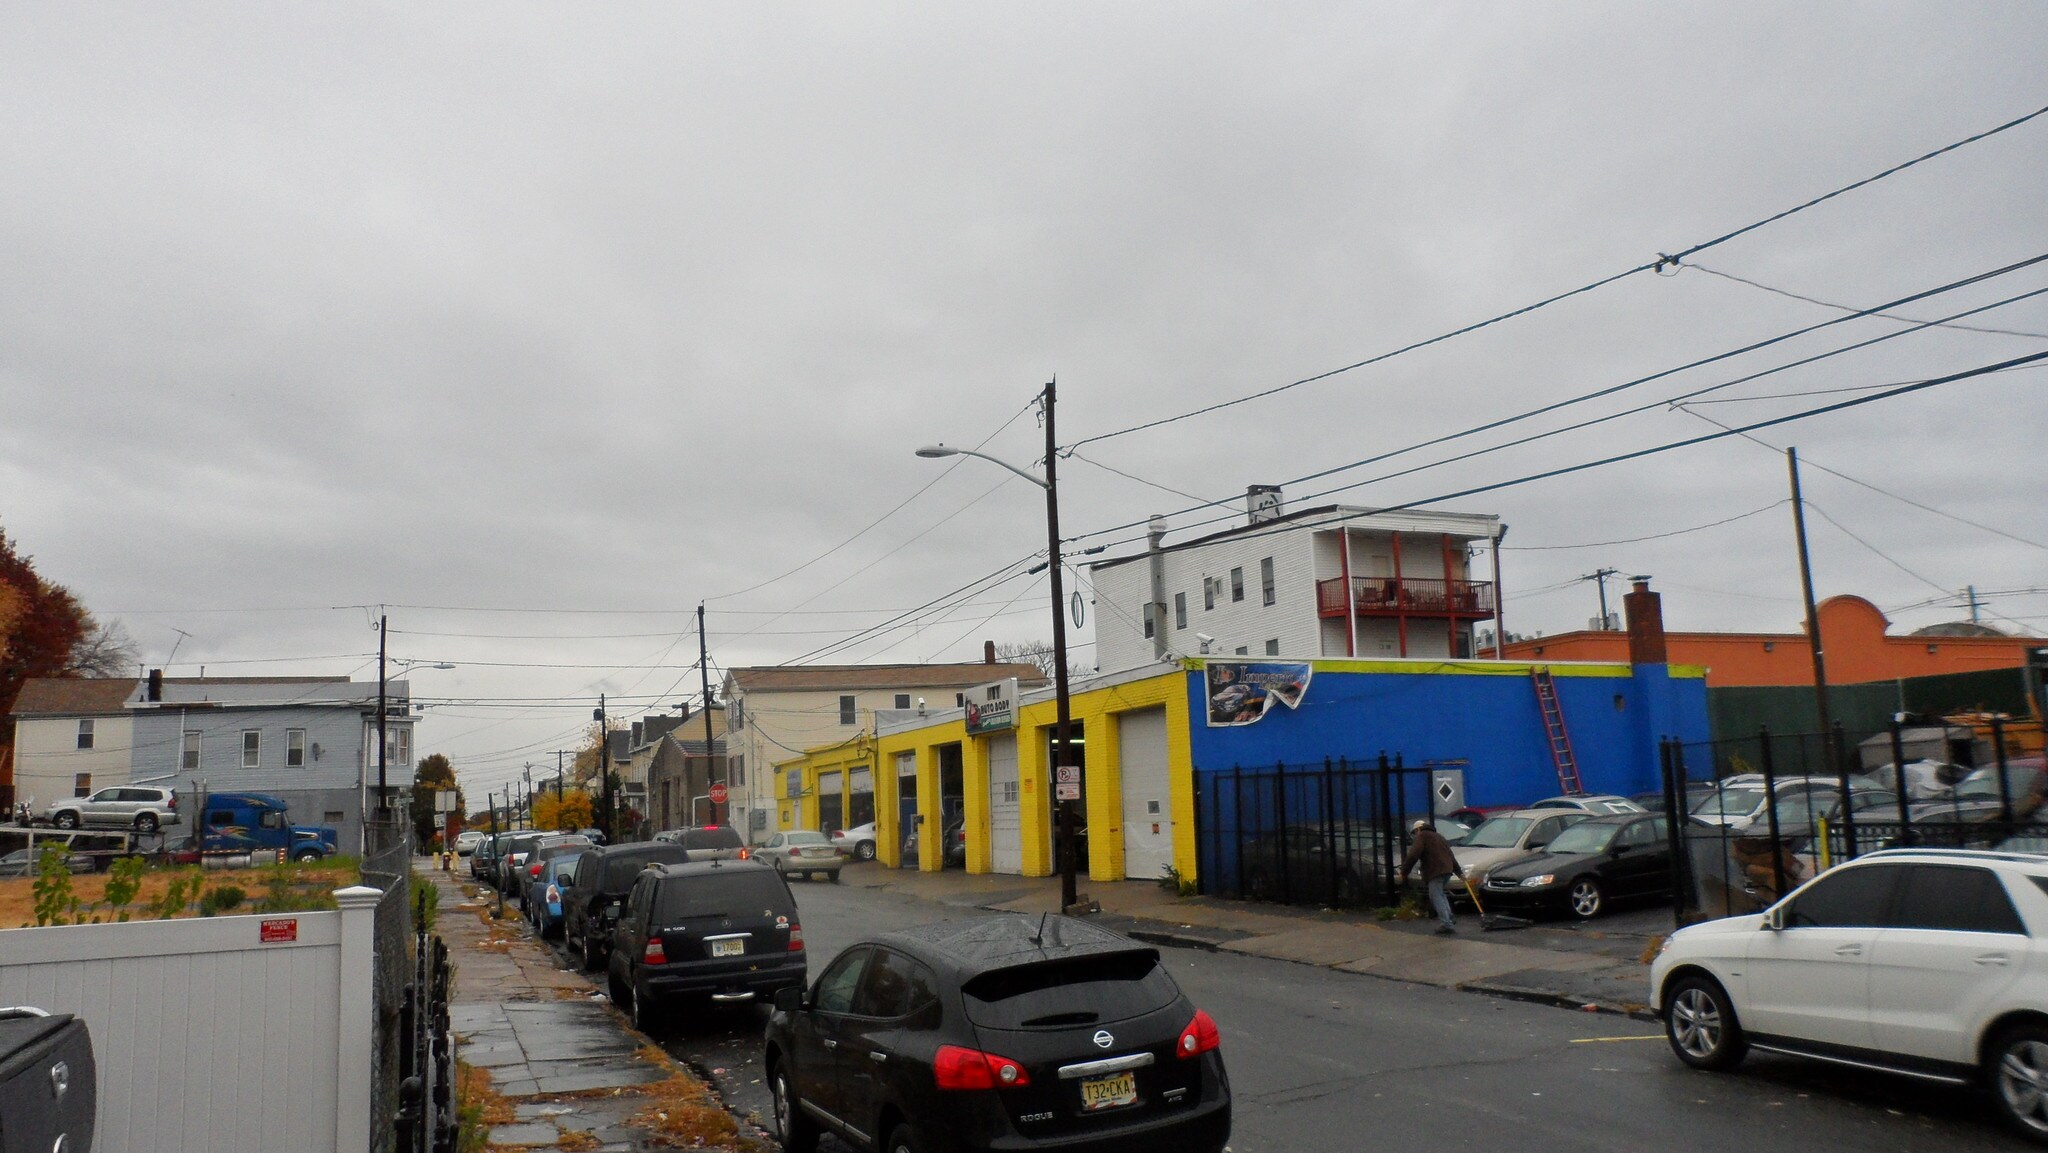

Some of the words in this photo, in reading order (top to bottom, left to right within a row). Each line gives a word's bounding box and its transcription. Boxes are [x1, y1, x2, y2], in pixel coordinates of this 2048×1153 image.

[980, 702, 994, 715] AUTO
[994, 699, 1009, 712] BODY
[710, 789, 727, 798] STOP
[1020, 1111, 1053, 1122] ROGUE
